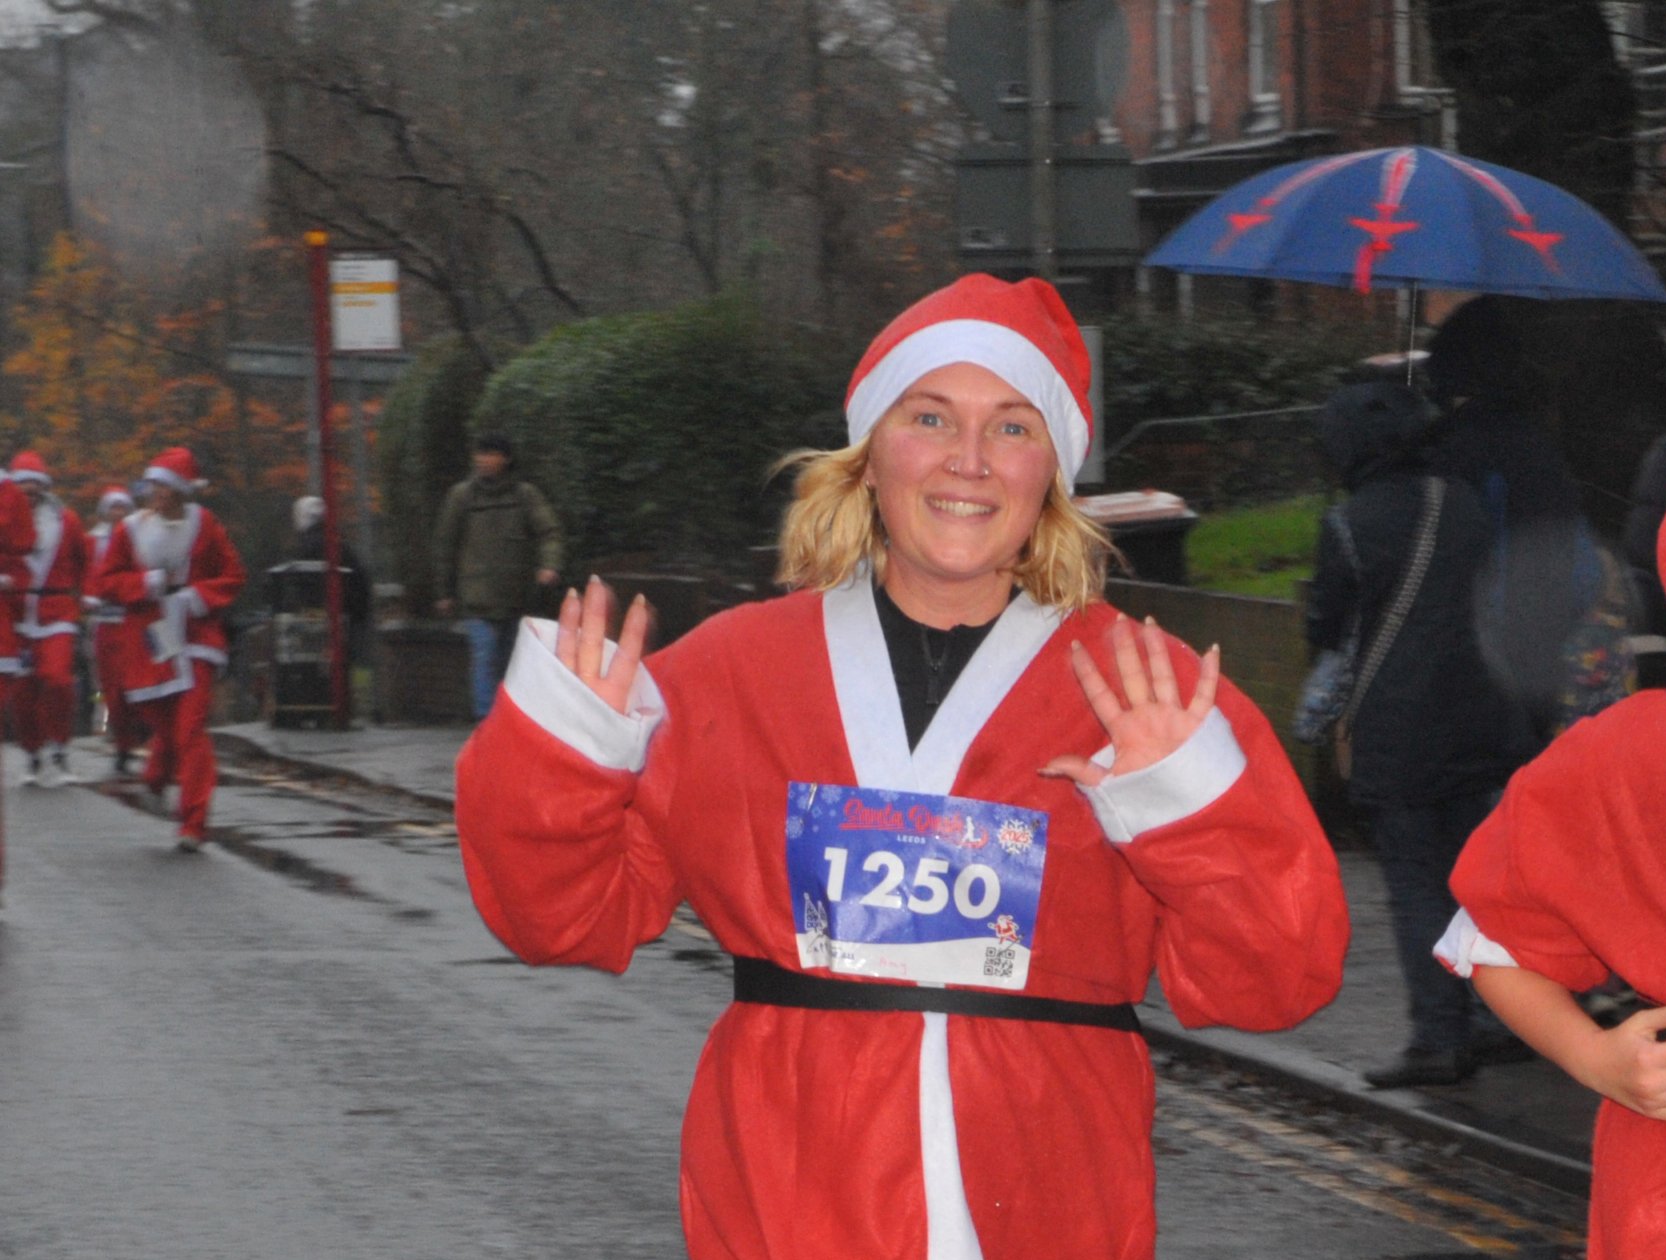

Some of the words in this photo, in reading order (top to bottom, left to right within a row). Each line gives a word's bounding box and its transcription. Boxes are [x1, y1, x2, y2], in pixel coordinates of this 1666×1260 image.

[840, 798, 905, 831] Santa
[896, 834, 926, 845] LEEDS
[1001, 828, 1030, 844] 2025
[824, 846, 1001, 919] 1250
